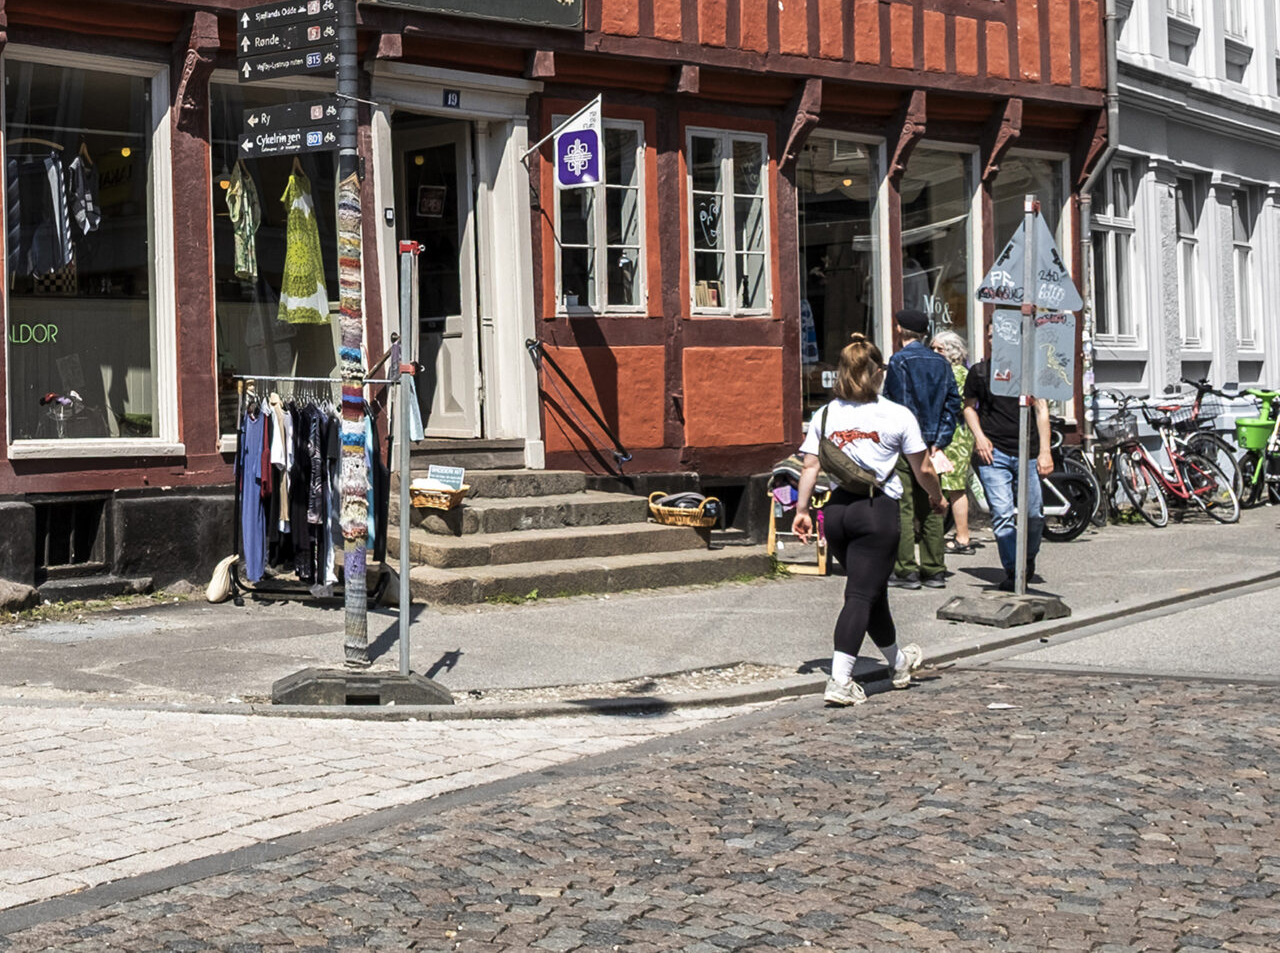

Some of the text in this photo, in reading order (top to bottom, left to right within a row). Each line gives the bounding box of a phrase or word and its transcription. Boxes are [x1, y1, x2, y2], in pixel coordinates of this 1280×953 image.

[282, 7, 297, 16] Odde
[254, 33, 280, 47] Rønde
[307, 55, 321, 65] 815
[447, 93, 458, 106] 19
[261, 112, 271, 126] Ry
[307, 133, 322, 144] 801
[9, 323, 59, 344] LDOR
